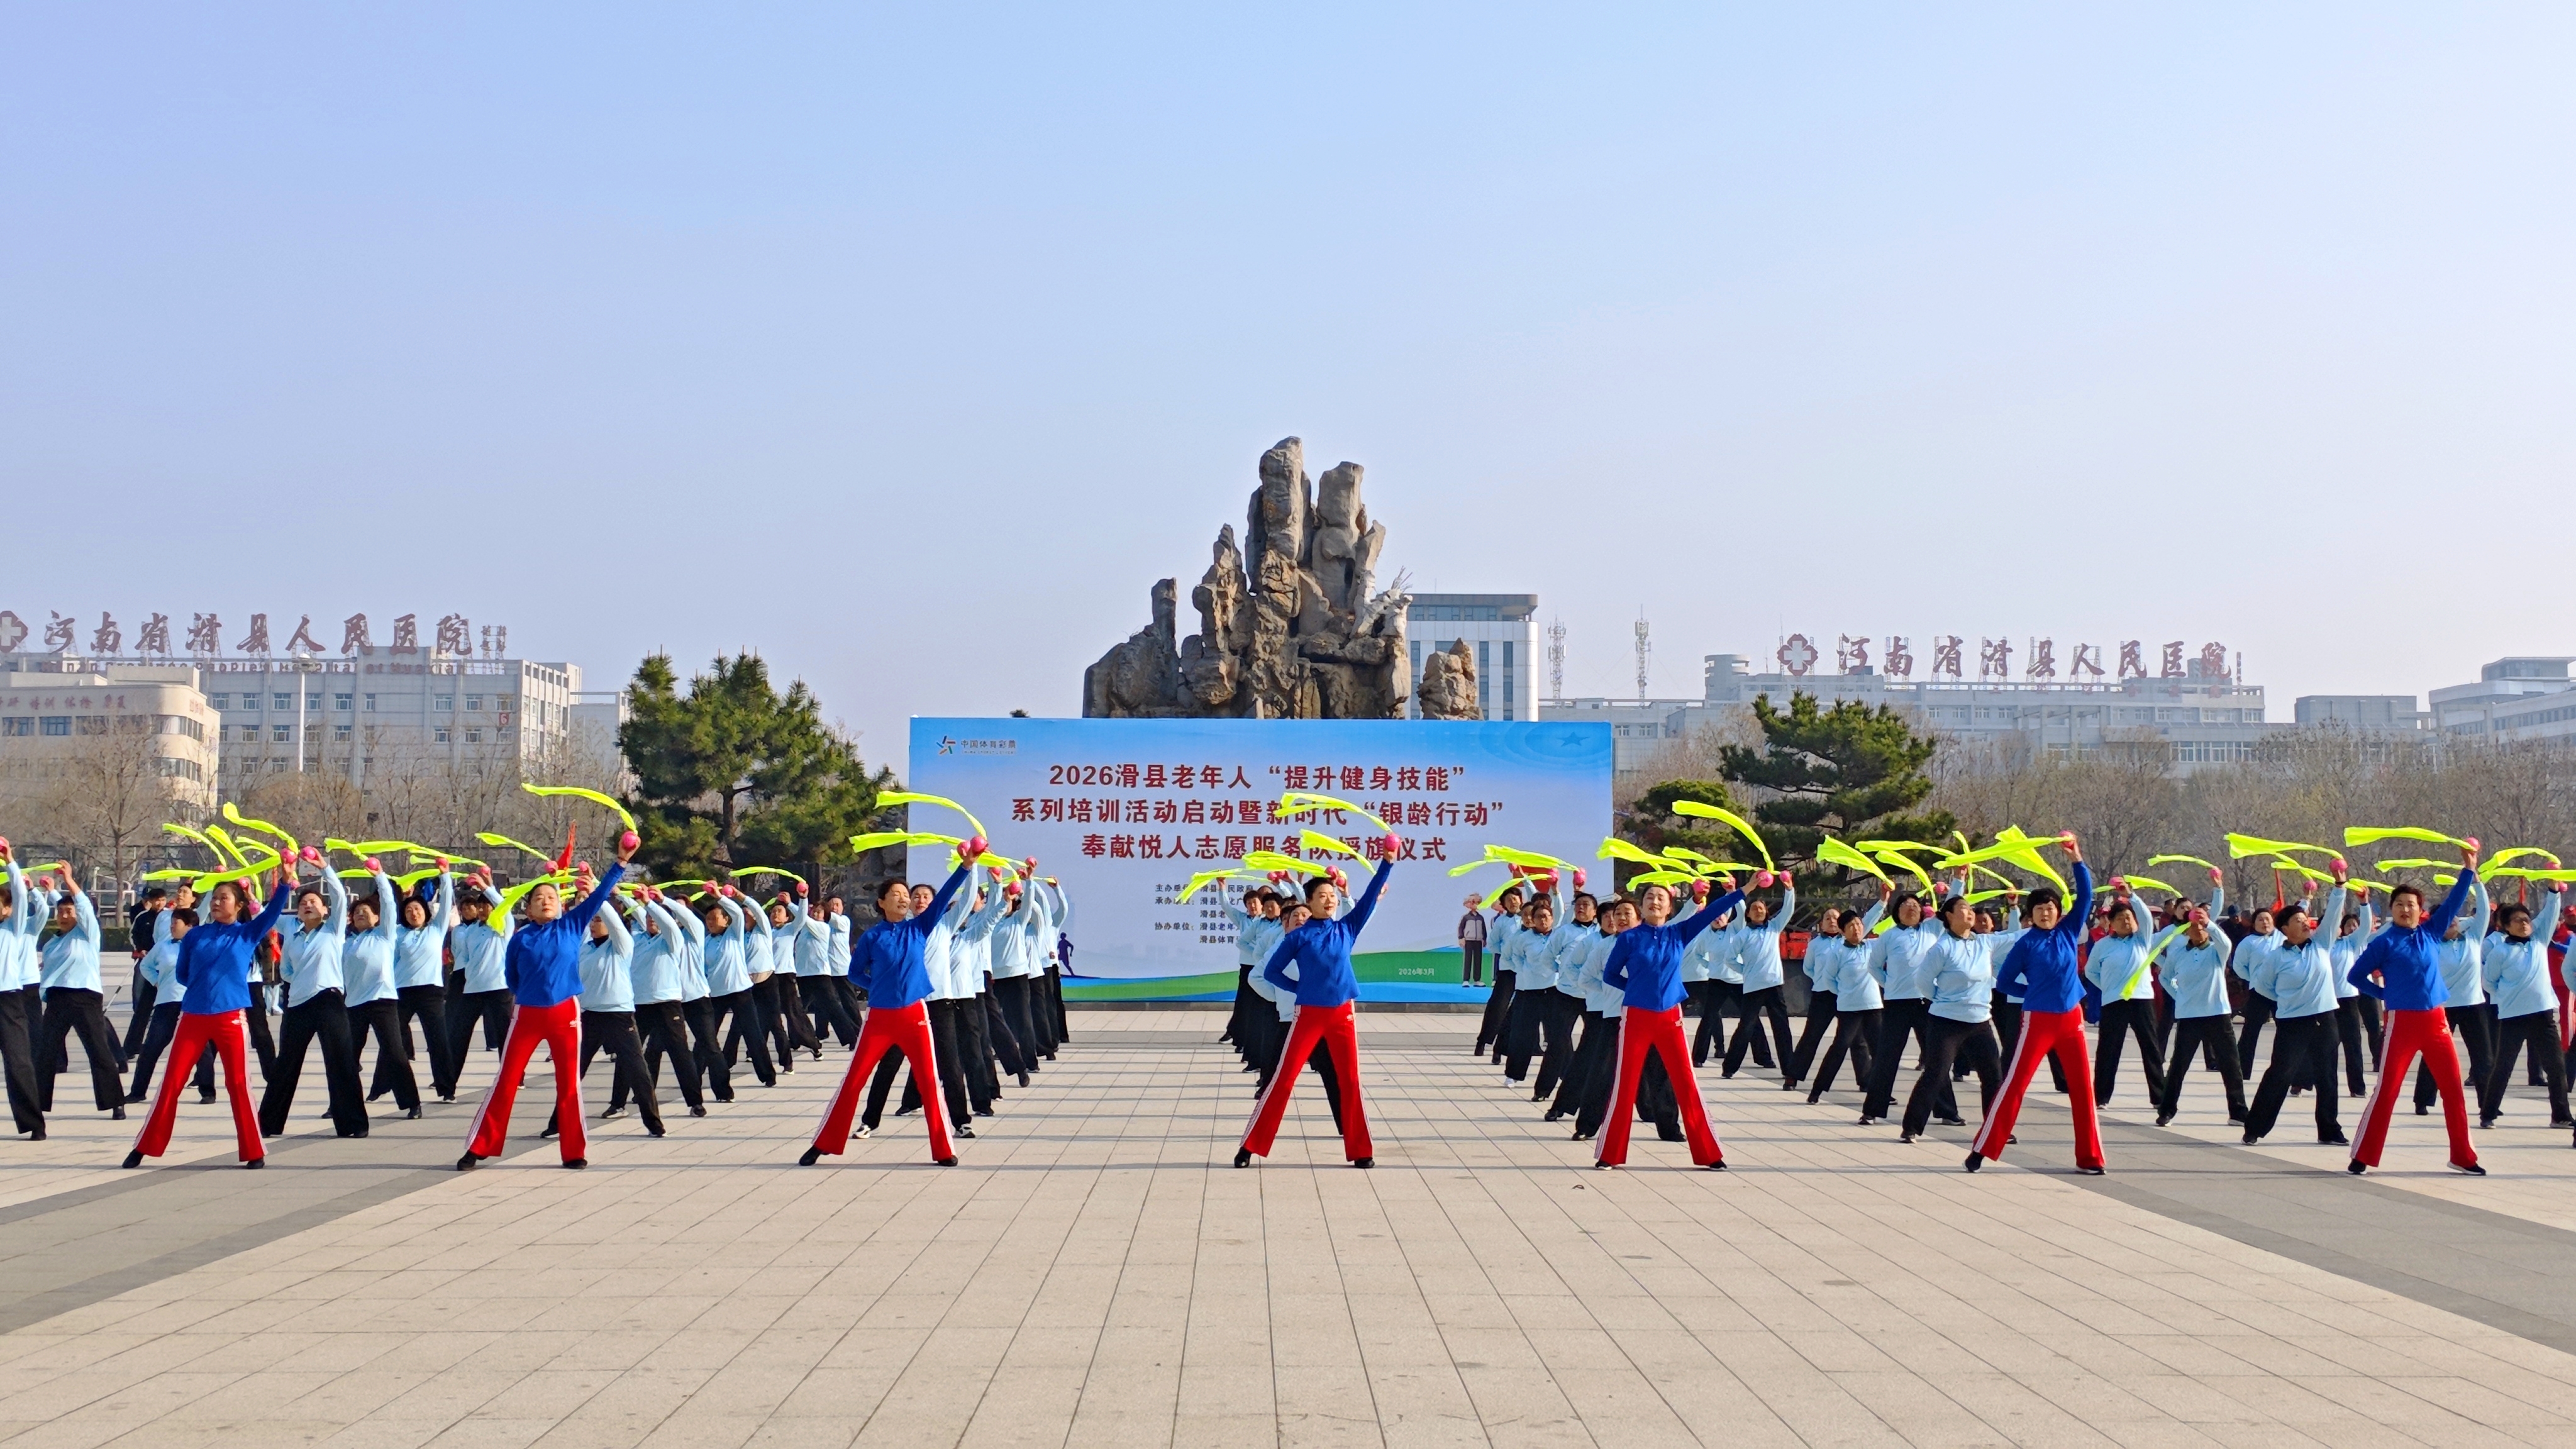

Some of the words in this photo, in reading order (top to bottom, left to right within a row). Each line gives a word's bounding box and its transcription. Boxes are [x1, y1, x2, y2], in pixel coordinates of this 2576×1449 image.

[43, 609, 472, 655] 河南省滑县人民医院
[1836, 633, 2232, 679] 河南省滑县人民医院
